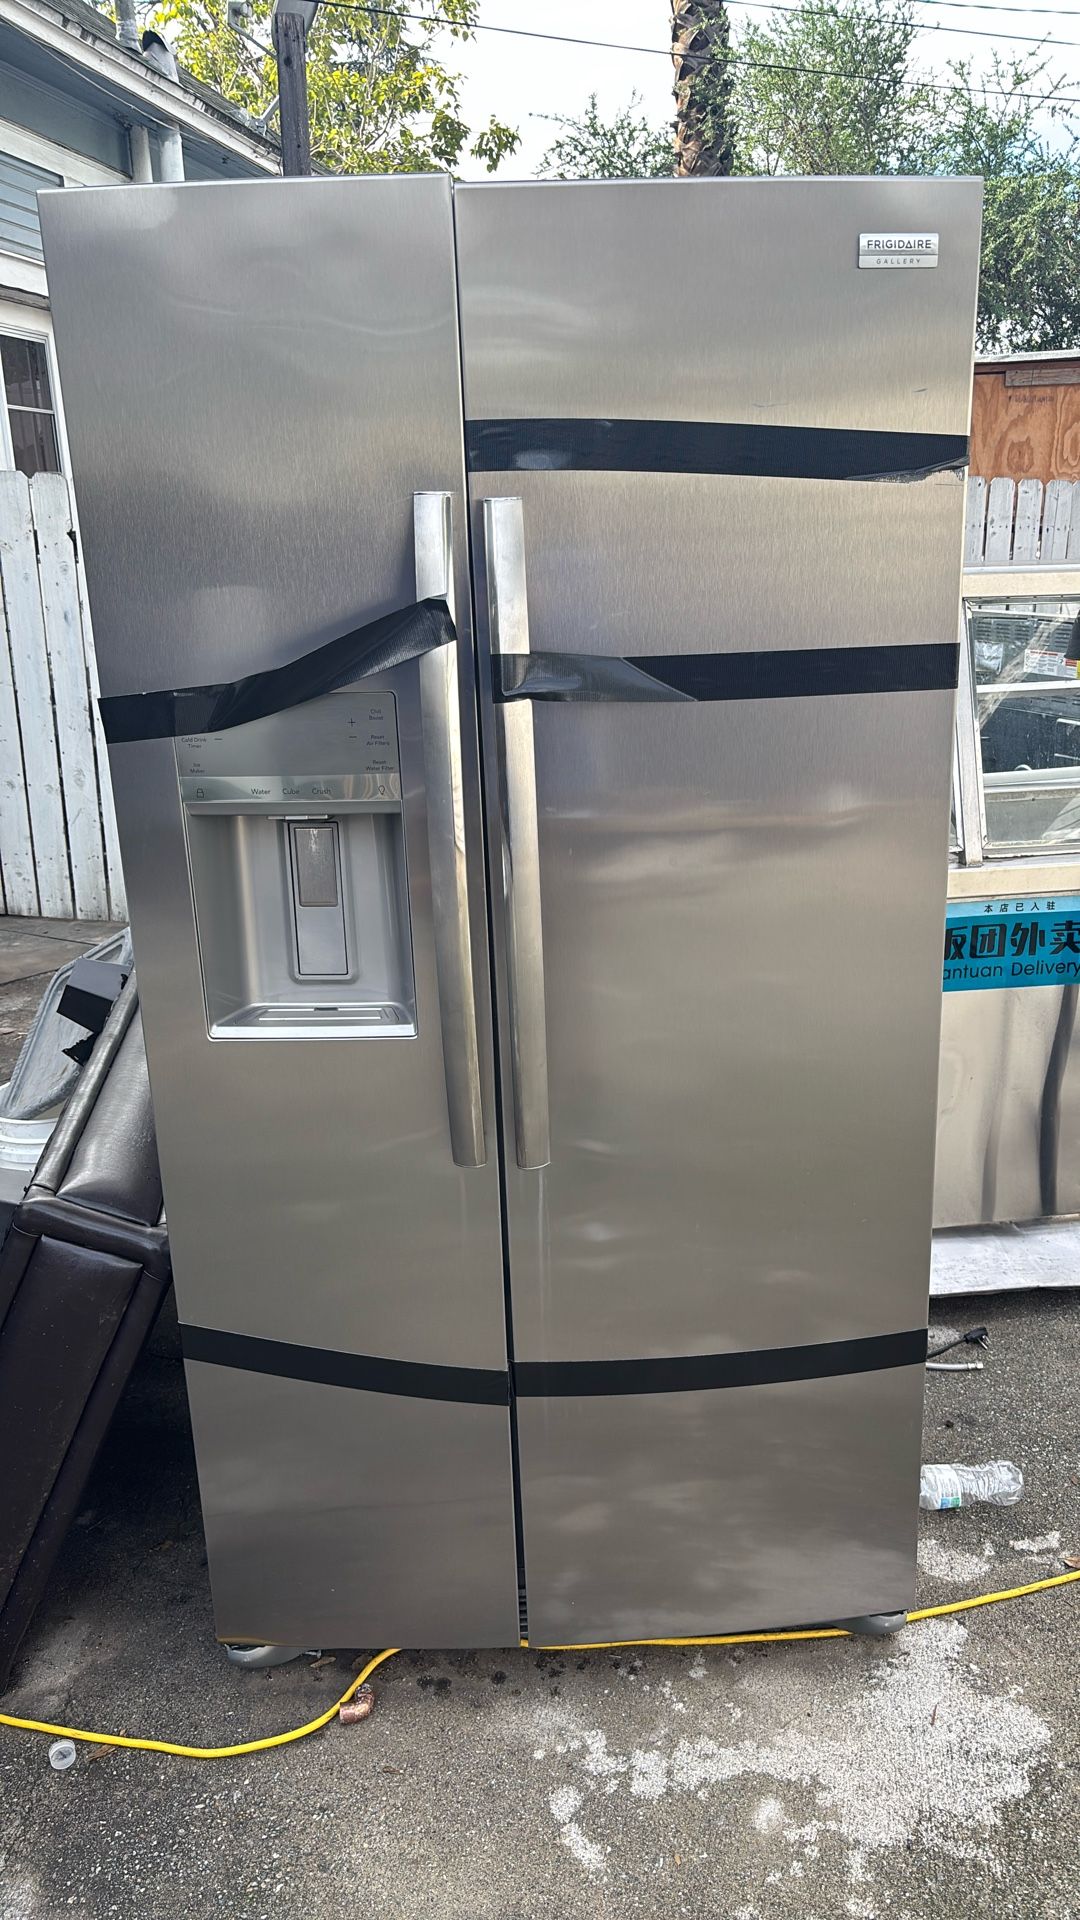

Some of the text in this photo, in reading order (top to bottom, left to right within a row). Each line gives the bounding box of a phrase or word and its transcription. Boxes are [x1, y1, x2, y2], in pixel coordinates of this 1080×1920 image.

[867, 240, 932, 249] FRIGIDAIRE
[282, 787, 300, 795] Cube
[311, 787, 331, 795] Crush
[984, 901, 1056, 913] 本店已入驻
[943, 960, 1080, 980] antuan Delivery
